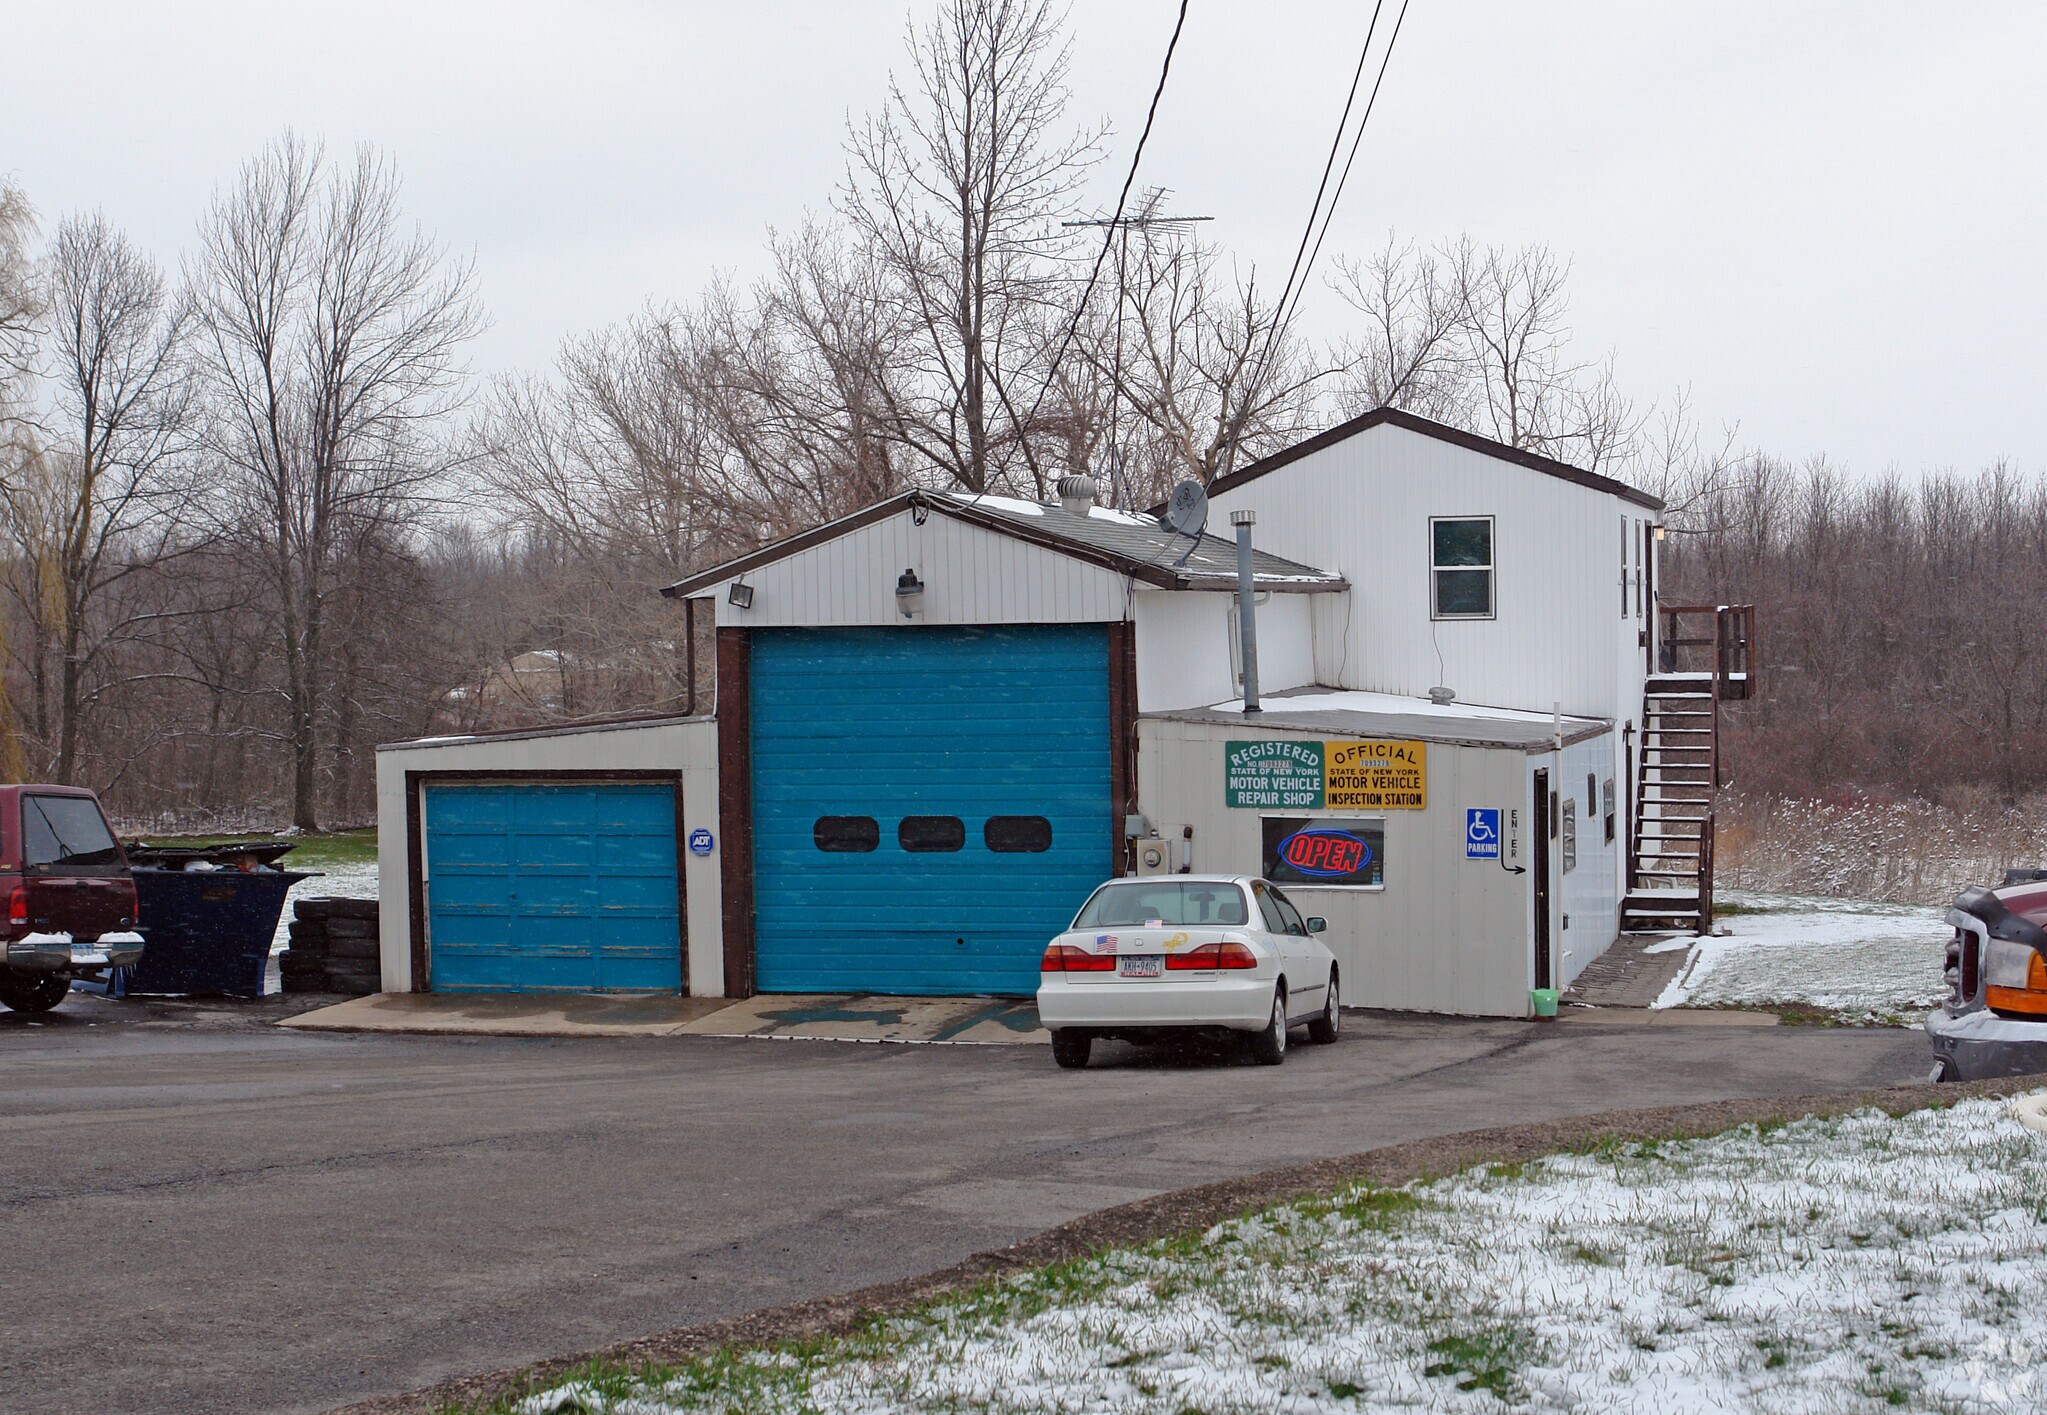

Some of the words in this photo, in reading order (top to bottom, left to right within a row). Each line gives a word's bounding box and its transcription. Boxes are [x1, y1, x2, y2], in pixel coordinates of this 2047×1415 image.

[1230, 742, 1319, 766] REGISTERED
[1334, 744, 1417, 765] OFFICIAL
[1295, 768, 1319, 776] YORK
[1229, 776, 1269, 790] MOTOR
[1271, 777, 1321, 791] VEHICLE
[1329, 776, 1368, 789] MOTOR
[1371, 777, 1421, 789] VEHICLE
[1237, 791, 1279, 805] REPAIR
[1282, 792, 1315, 805] SHOP
[1328, 792, 1382, 805] INSPECTION
[693, 836, 710, 846] ADT
[1288, 834, 1363, 873] OPEN
[1468, 843, 1497, 853] PARKING
